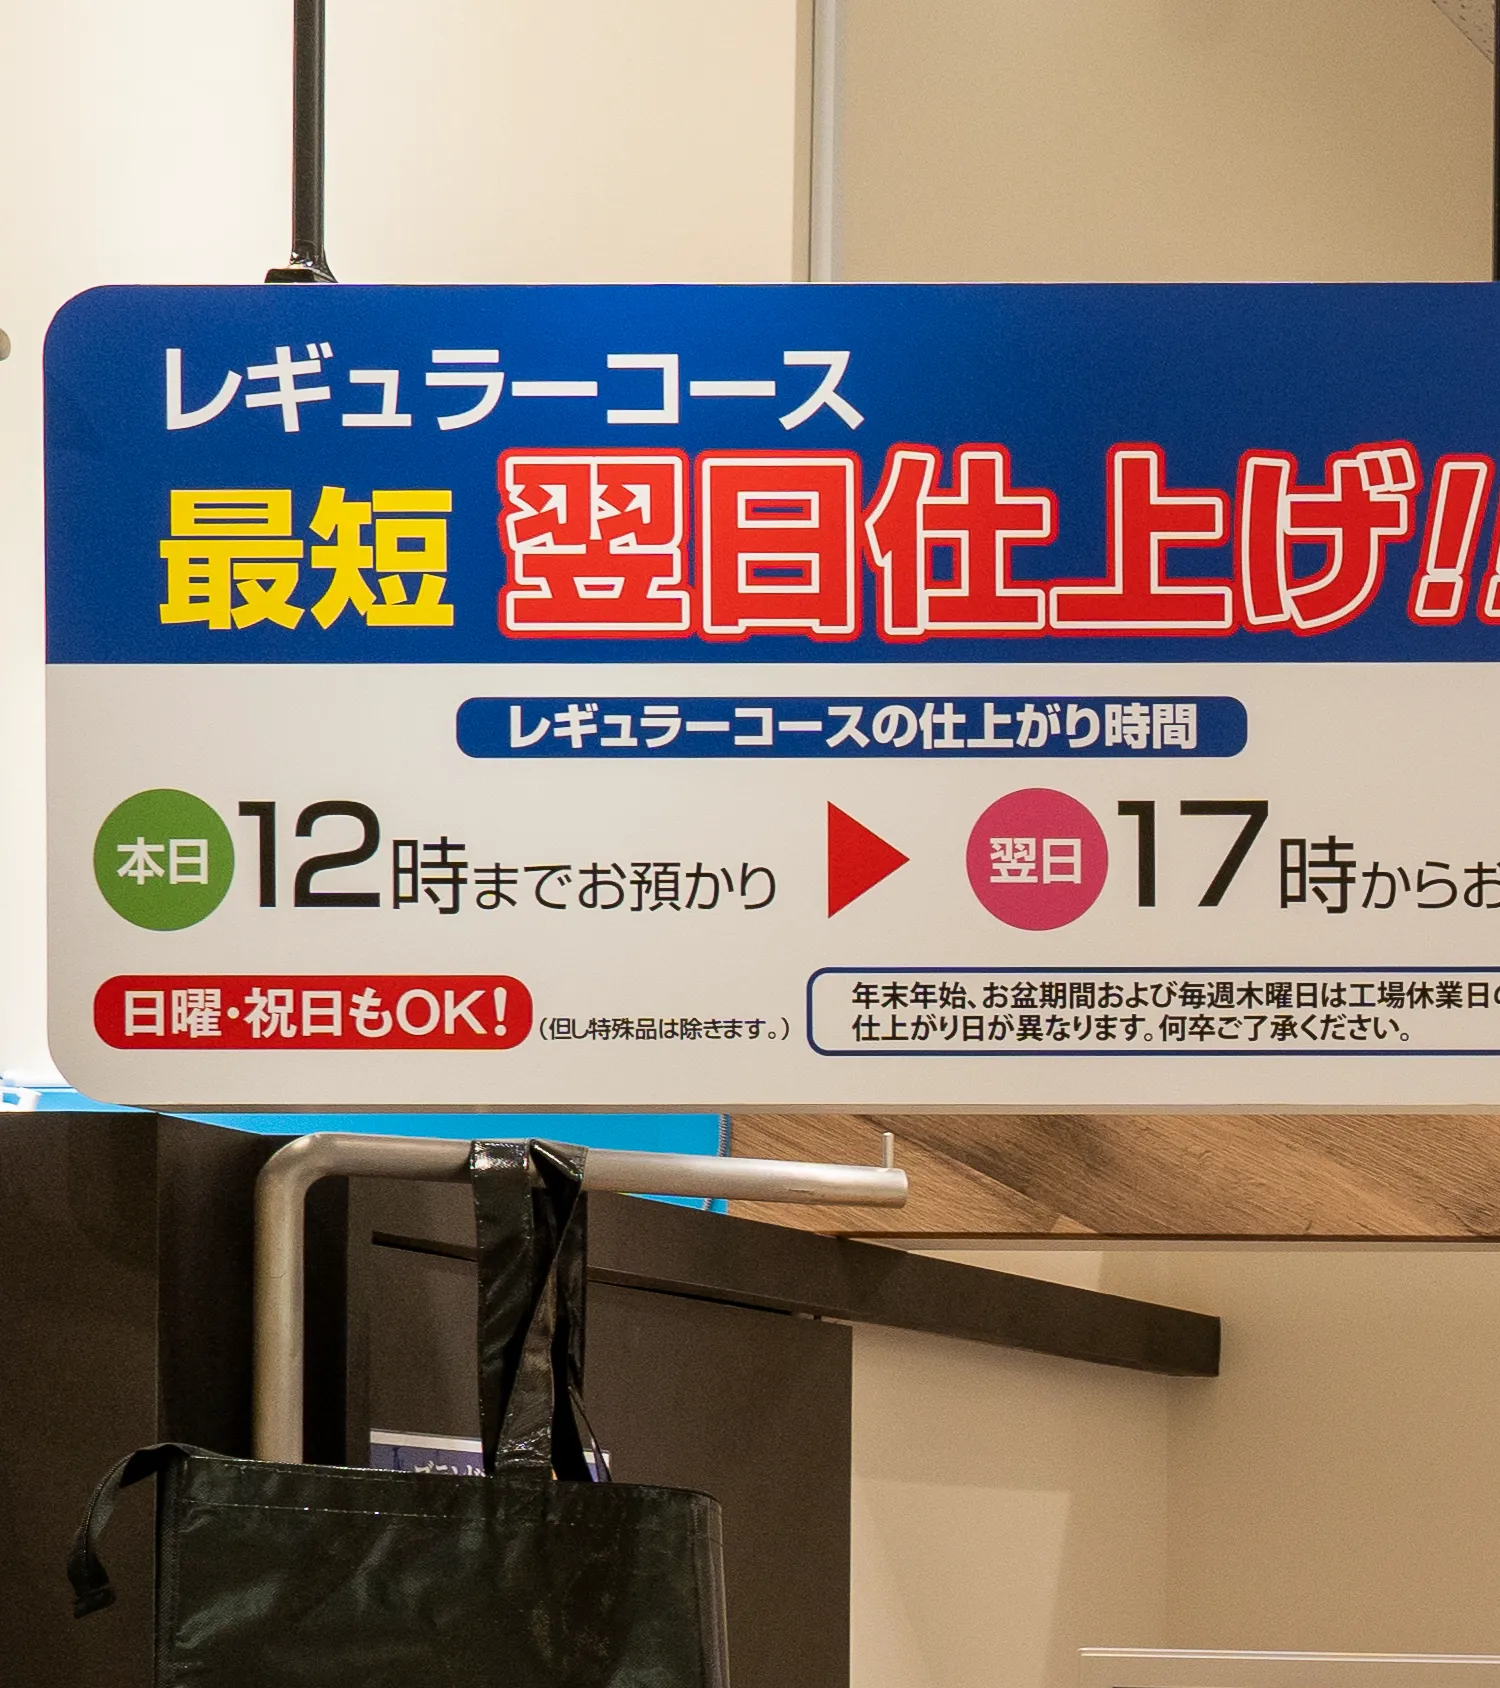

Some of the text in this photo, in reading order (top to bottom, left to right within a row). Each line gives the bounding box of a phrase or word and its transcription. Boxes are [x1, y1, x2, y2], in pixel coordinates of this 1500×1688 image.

[166, 342, 864, 432] レギュラーコース
[159, 485, 455, 630] 最短
[509, 702, 1197, 750] レギュラーコースの仕上がり時間
[117, 837, 210, 885] 本日
[238, 800, 777, 914] 12時までお預かり
[990, 837, 1081, 885] 翌日
[122, 988, 508, 1039] 日曜・祝日もOK!
[852, 1014, 1413, 1042] 仕上がり日が異なります。何卒ご了承ください。
